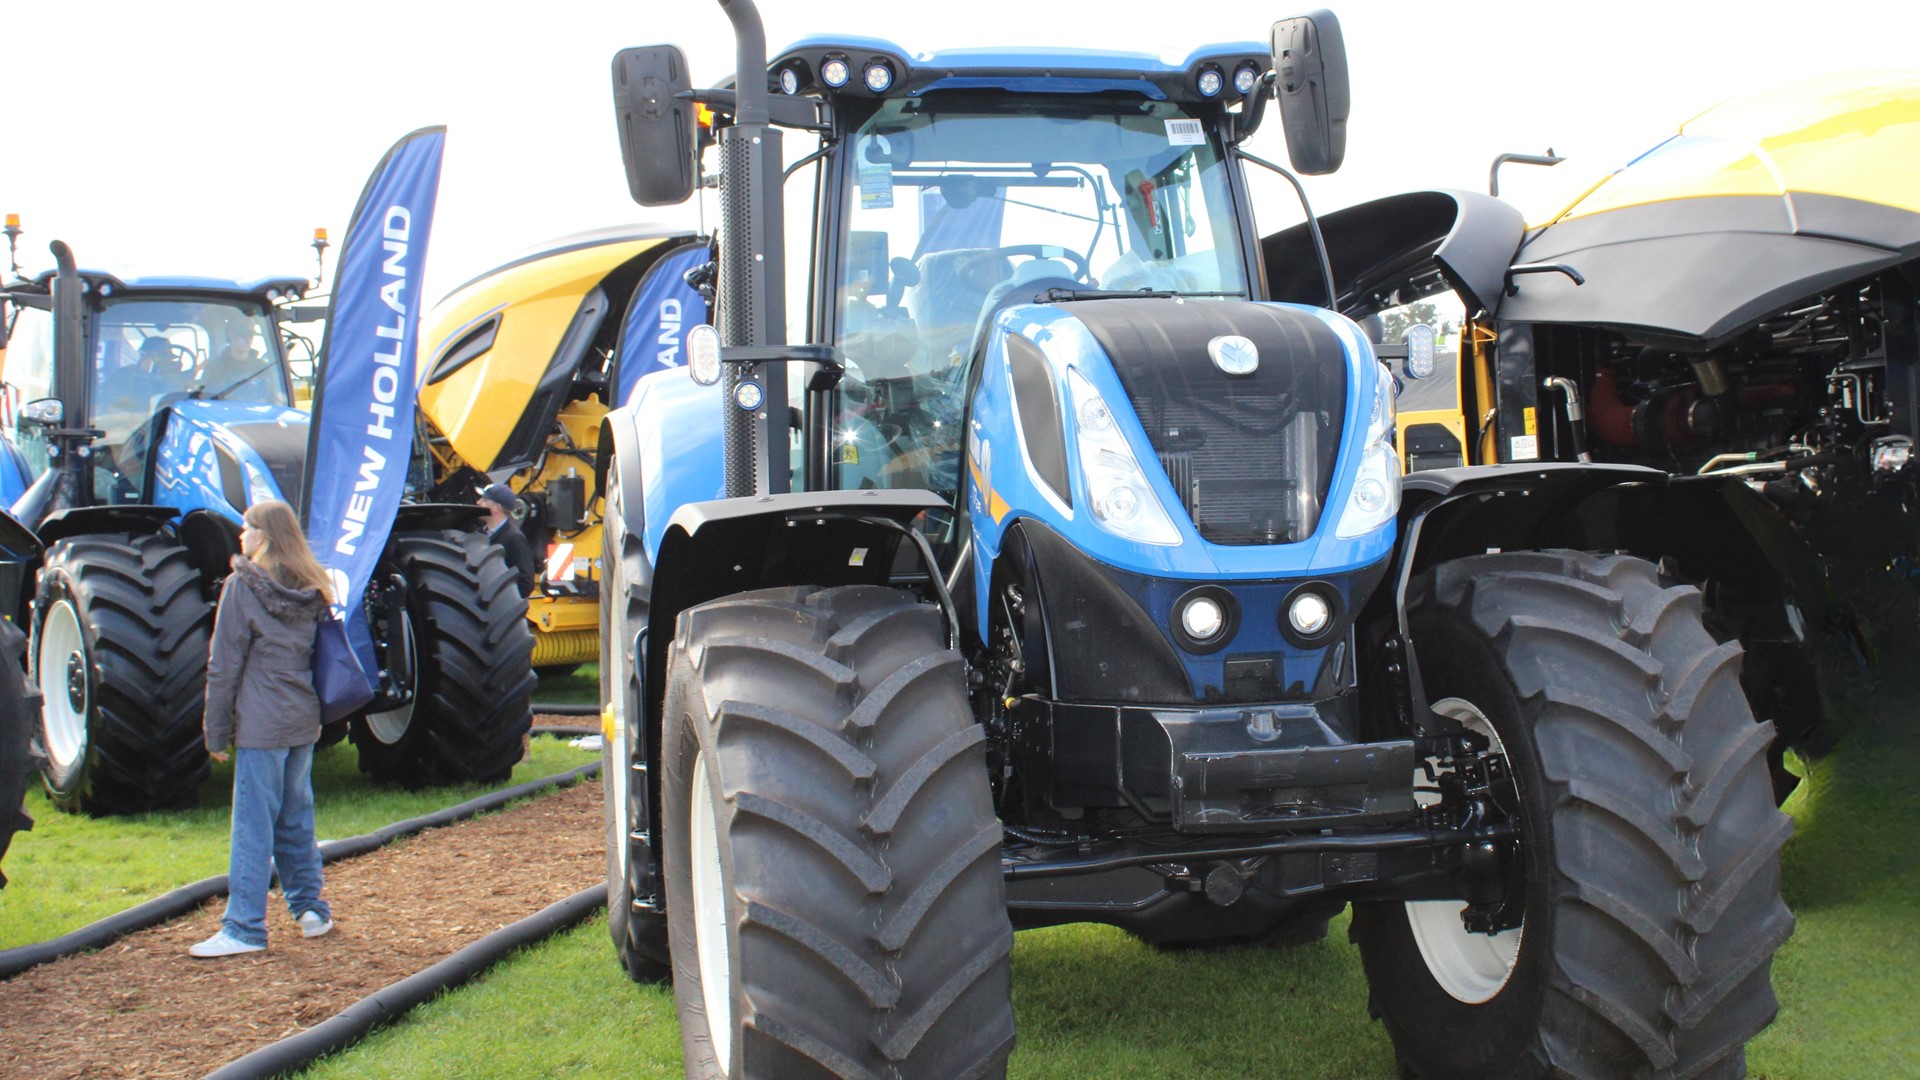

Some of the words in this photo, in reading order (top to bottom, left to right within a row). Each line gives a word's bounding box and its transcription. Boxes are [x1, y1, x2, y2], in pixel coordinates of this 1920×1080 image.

[335, 445, 387, 556] NEW
[366, 205, 411, 440] HOLLAND
[657, 298, 682, 368] AND
